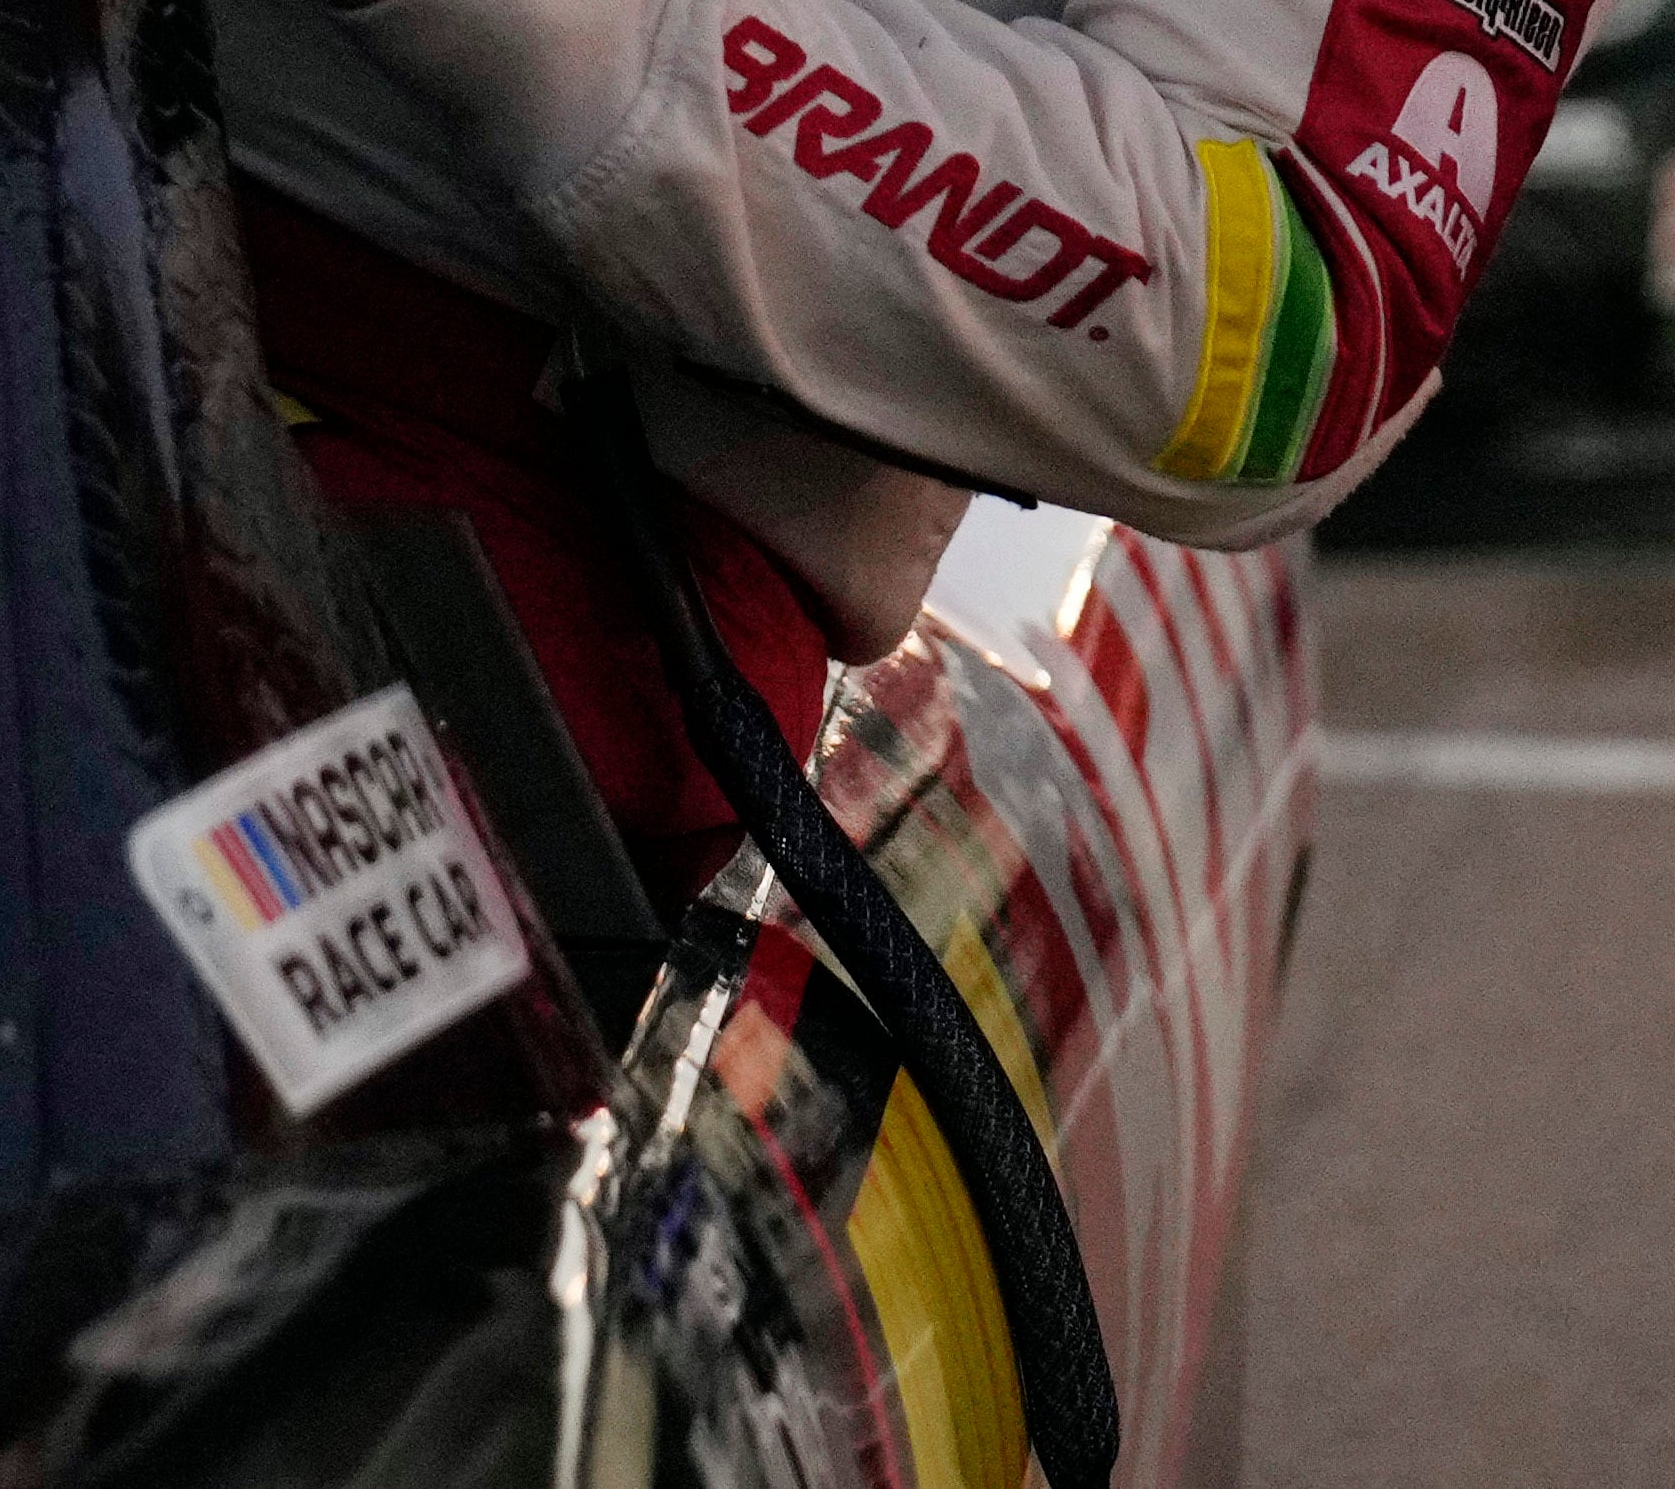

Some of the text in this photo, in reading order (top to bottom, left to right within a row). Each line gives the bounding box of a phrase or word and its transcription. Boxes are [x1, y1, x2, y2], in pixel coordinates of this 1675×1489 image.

[1347, 141, 1480, 283] AXALTA
[256, 731, 448, 899] NASCAR
[275, 860, 494, 1038] RACE CAR
